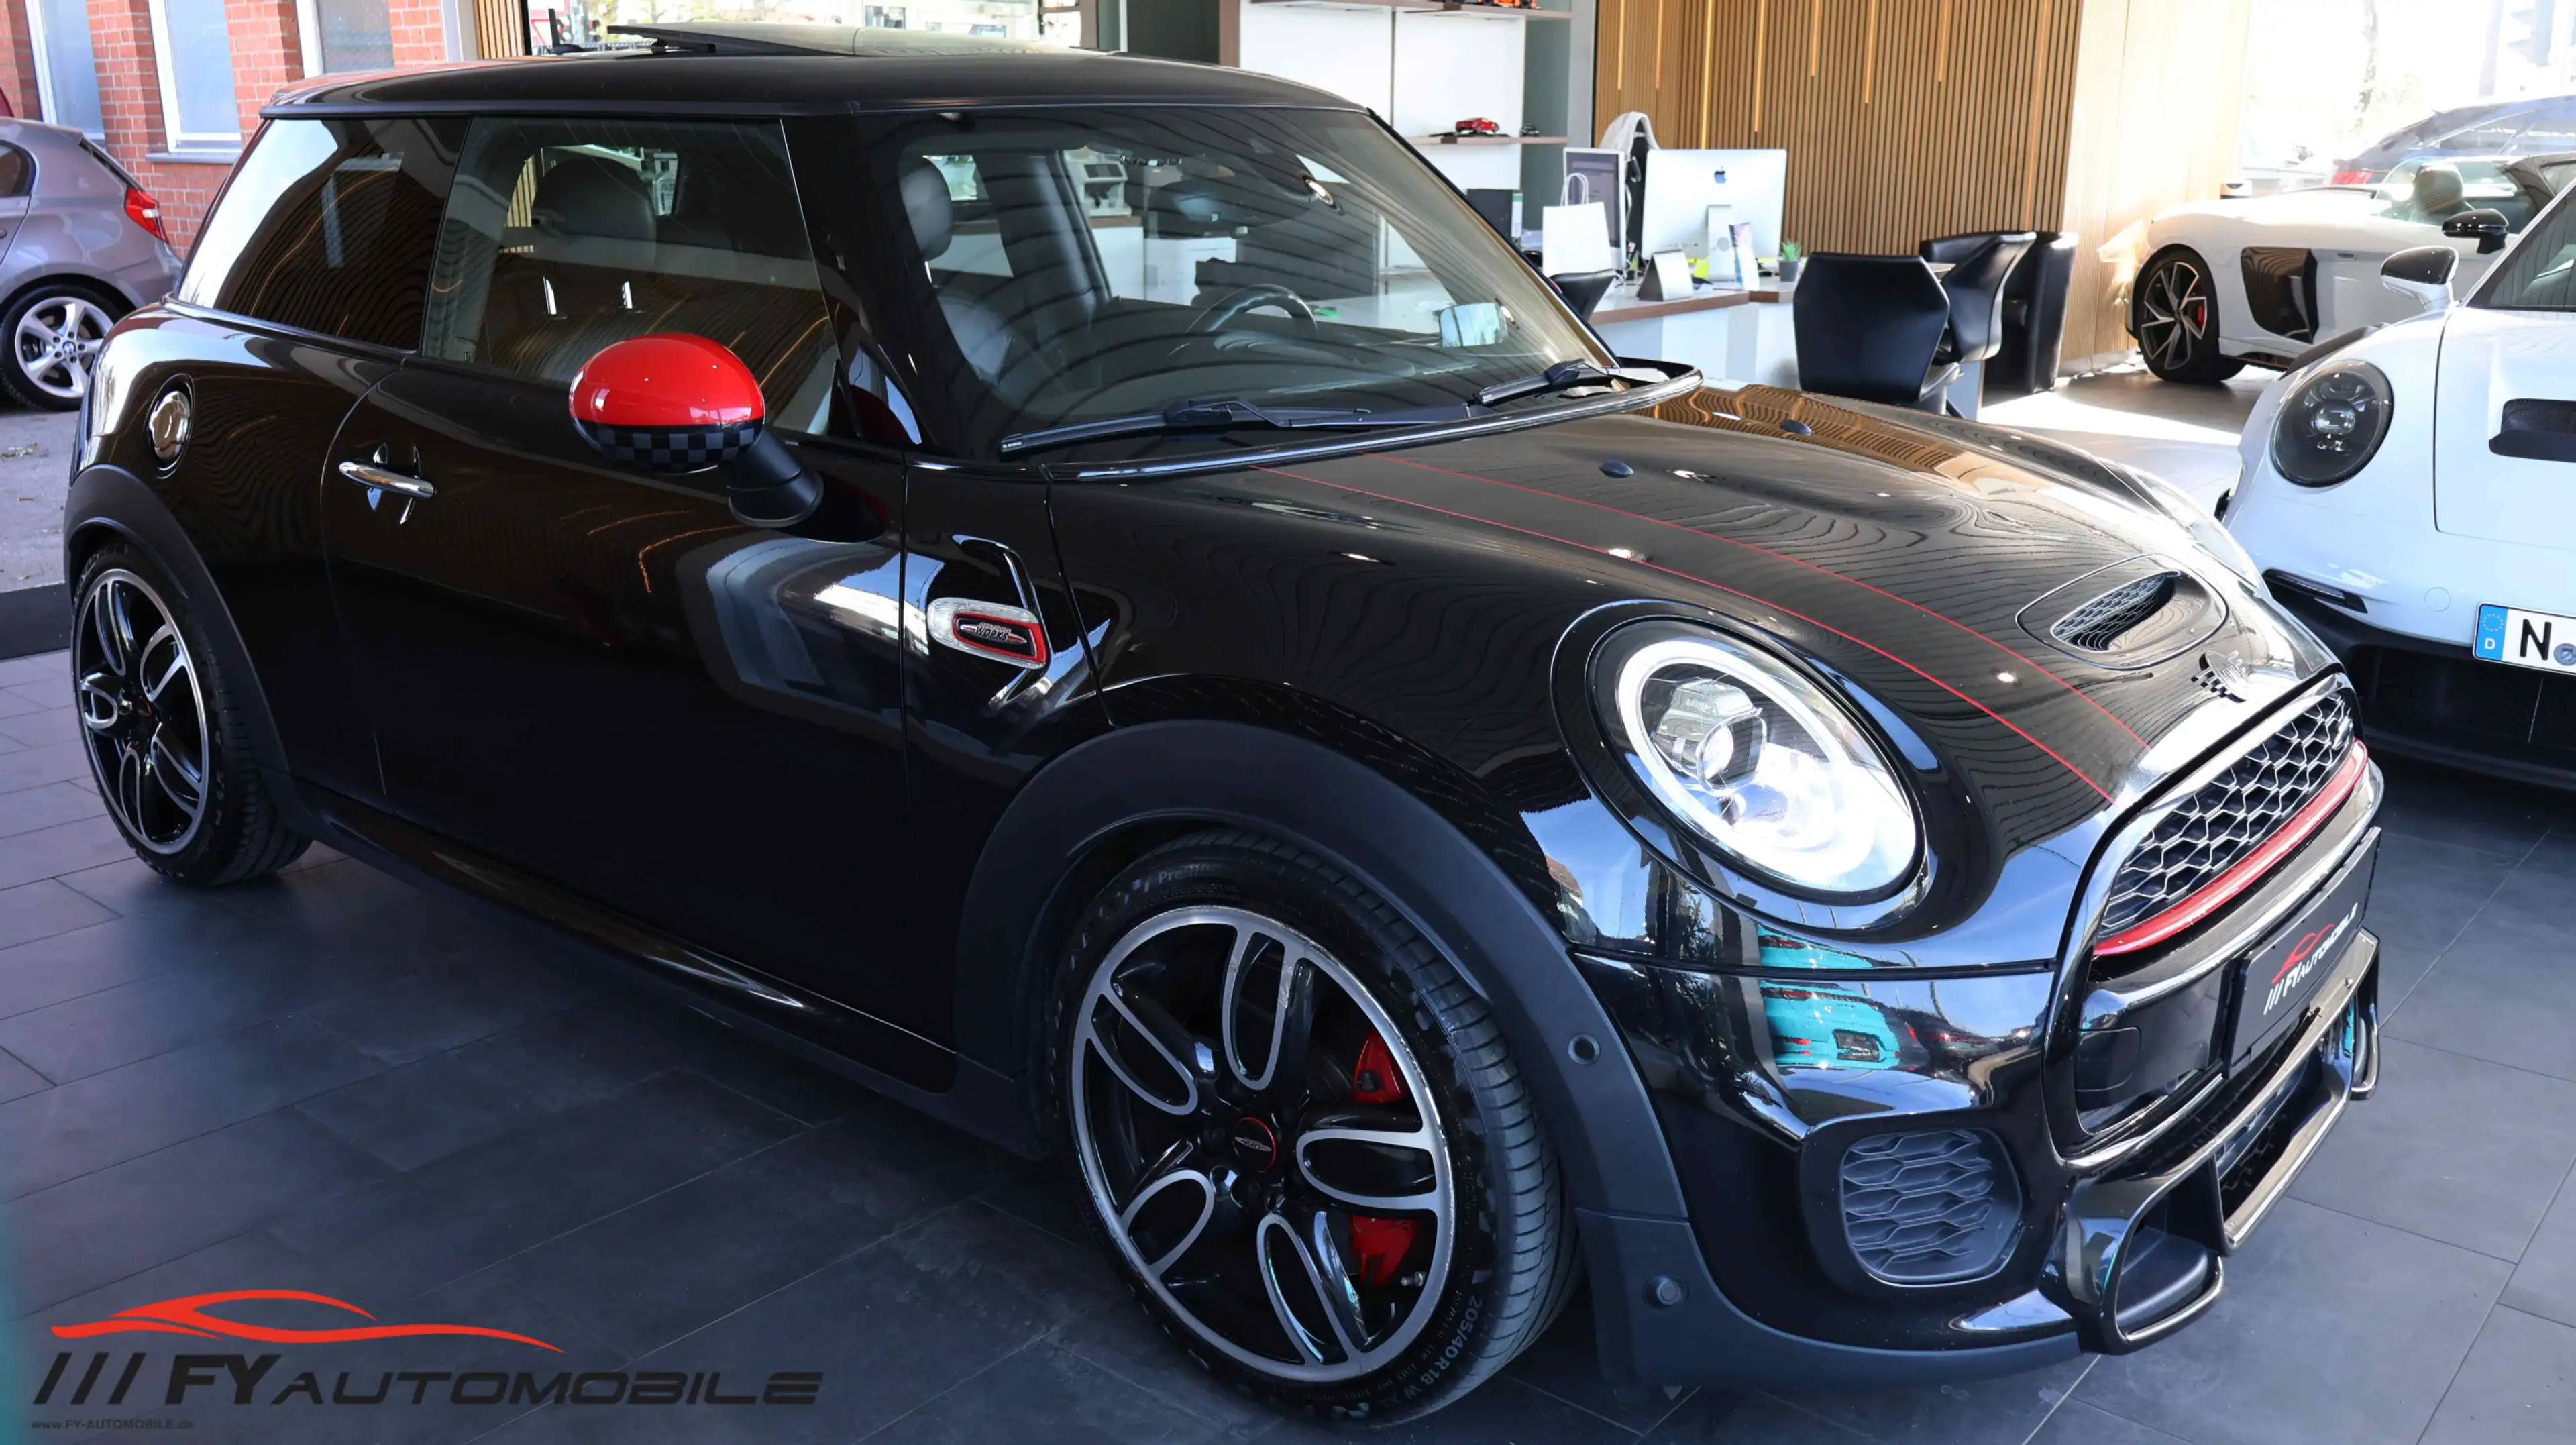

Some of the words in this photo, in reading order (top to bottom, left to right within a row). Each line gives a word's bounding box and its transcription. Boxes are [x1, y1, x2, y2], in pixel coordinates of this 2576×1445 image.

[976, 628, 1008, 641] WORKS
[2520, 619, 2551, 661] N
[2484, 637, 2496, 650] D
